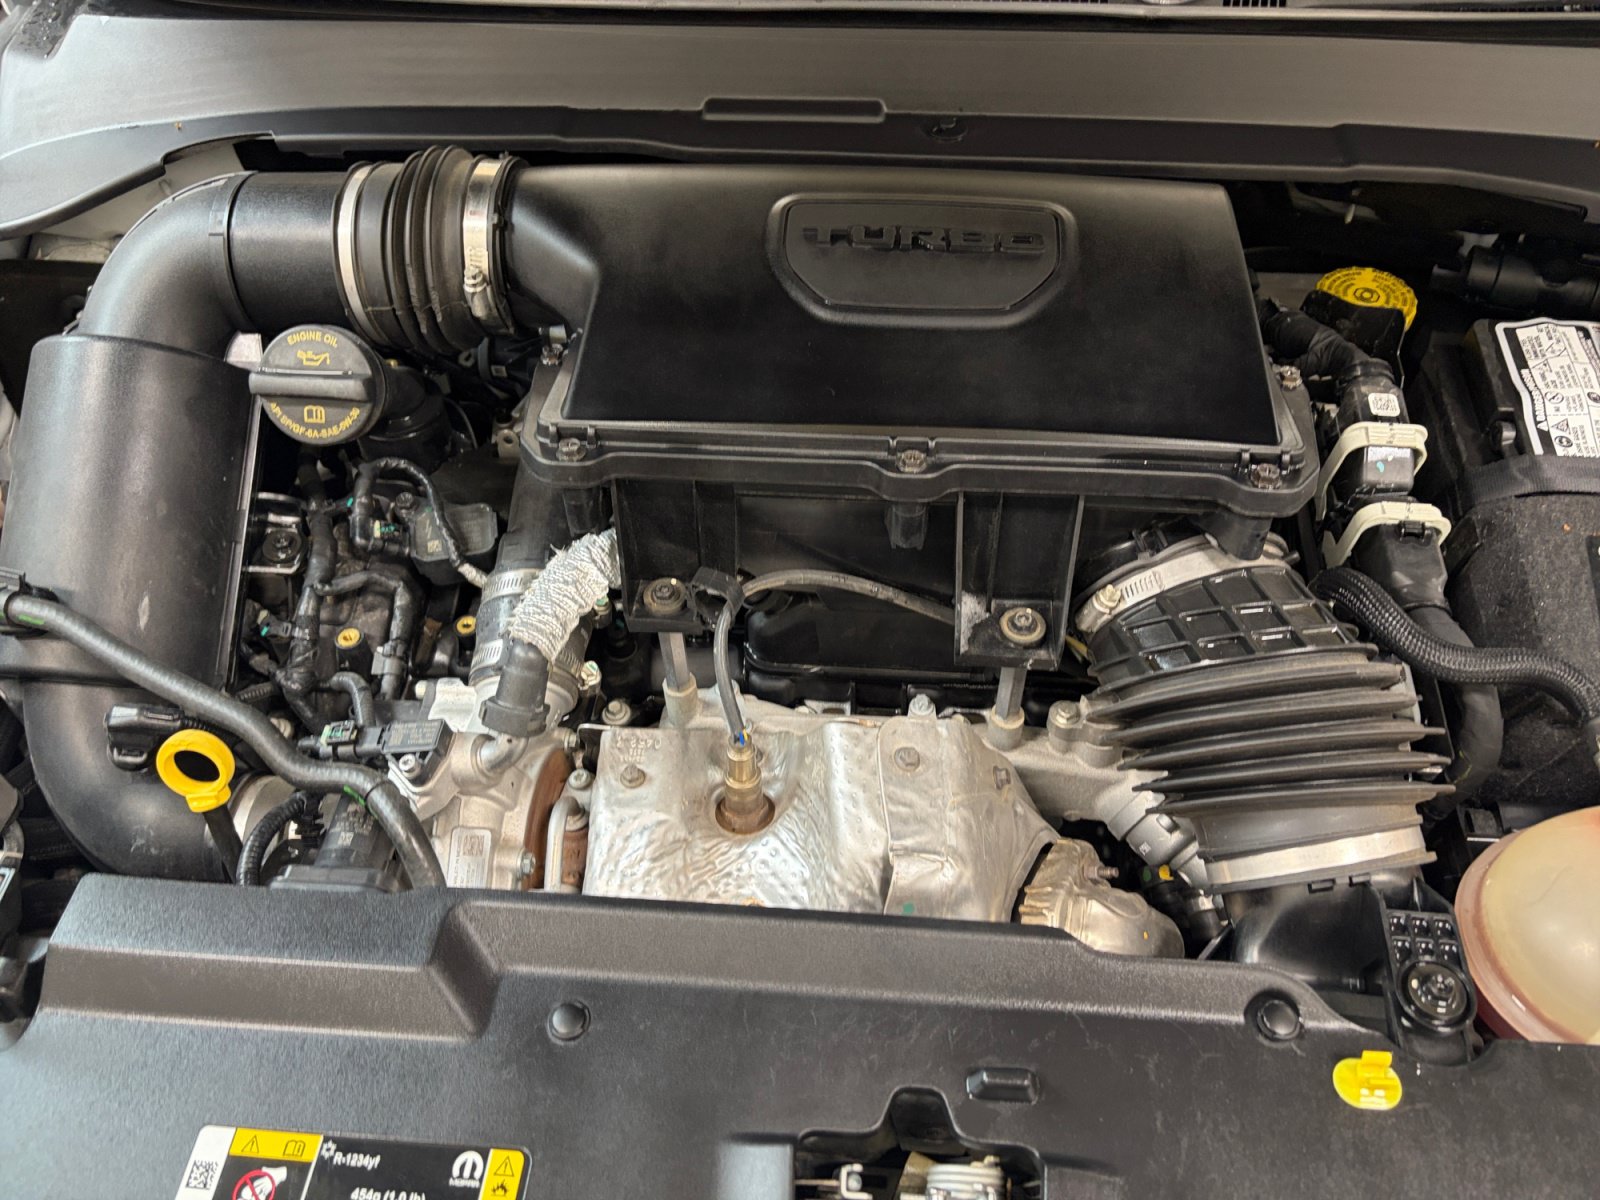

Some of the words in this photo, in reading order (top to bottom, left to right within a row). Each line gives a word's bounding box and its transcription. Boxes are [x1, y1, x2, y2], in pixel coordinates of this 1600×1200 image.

[802, 225, 1046, 253] TURBO
[287, 331, 321, 345] ENGINE
[324, 333, 338, 348] OIL
[333, 1151, 381, 1171] R-1234yf
